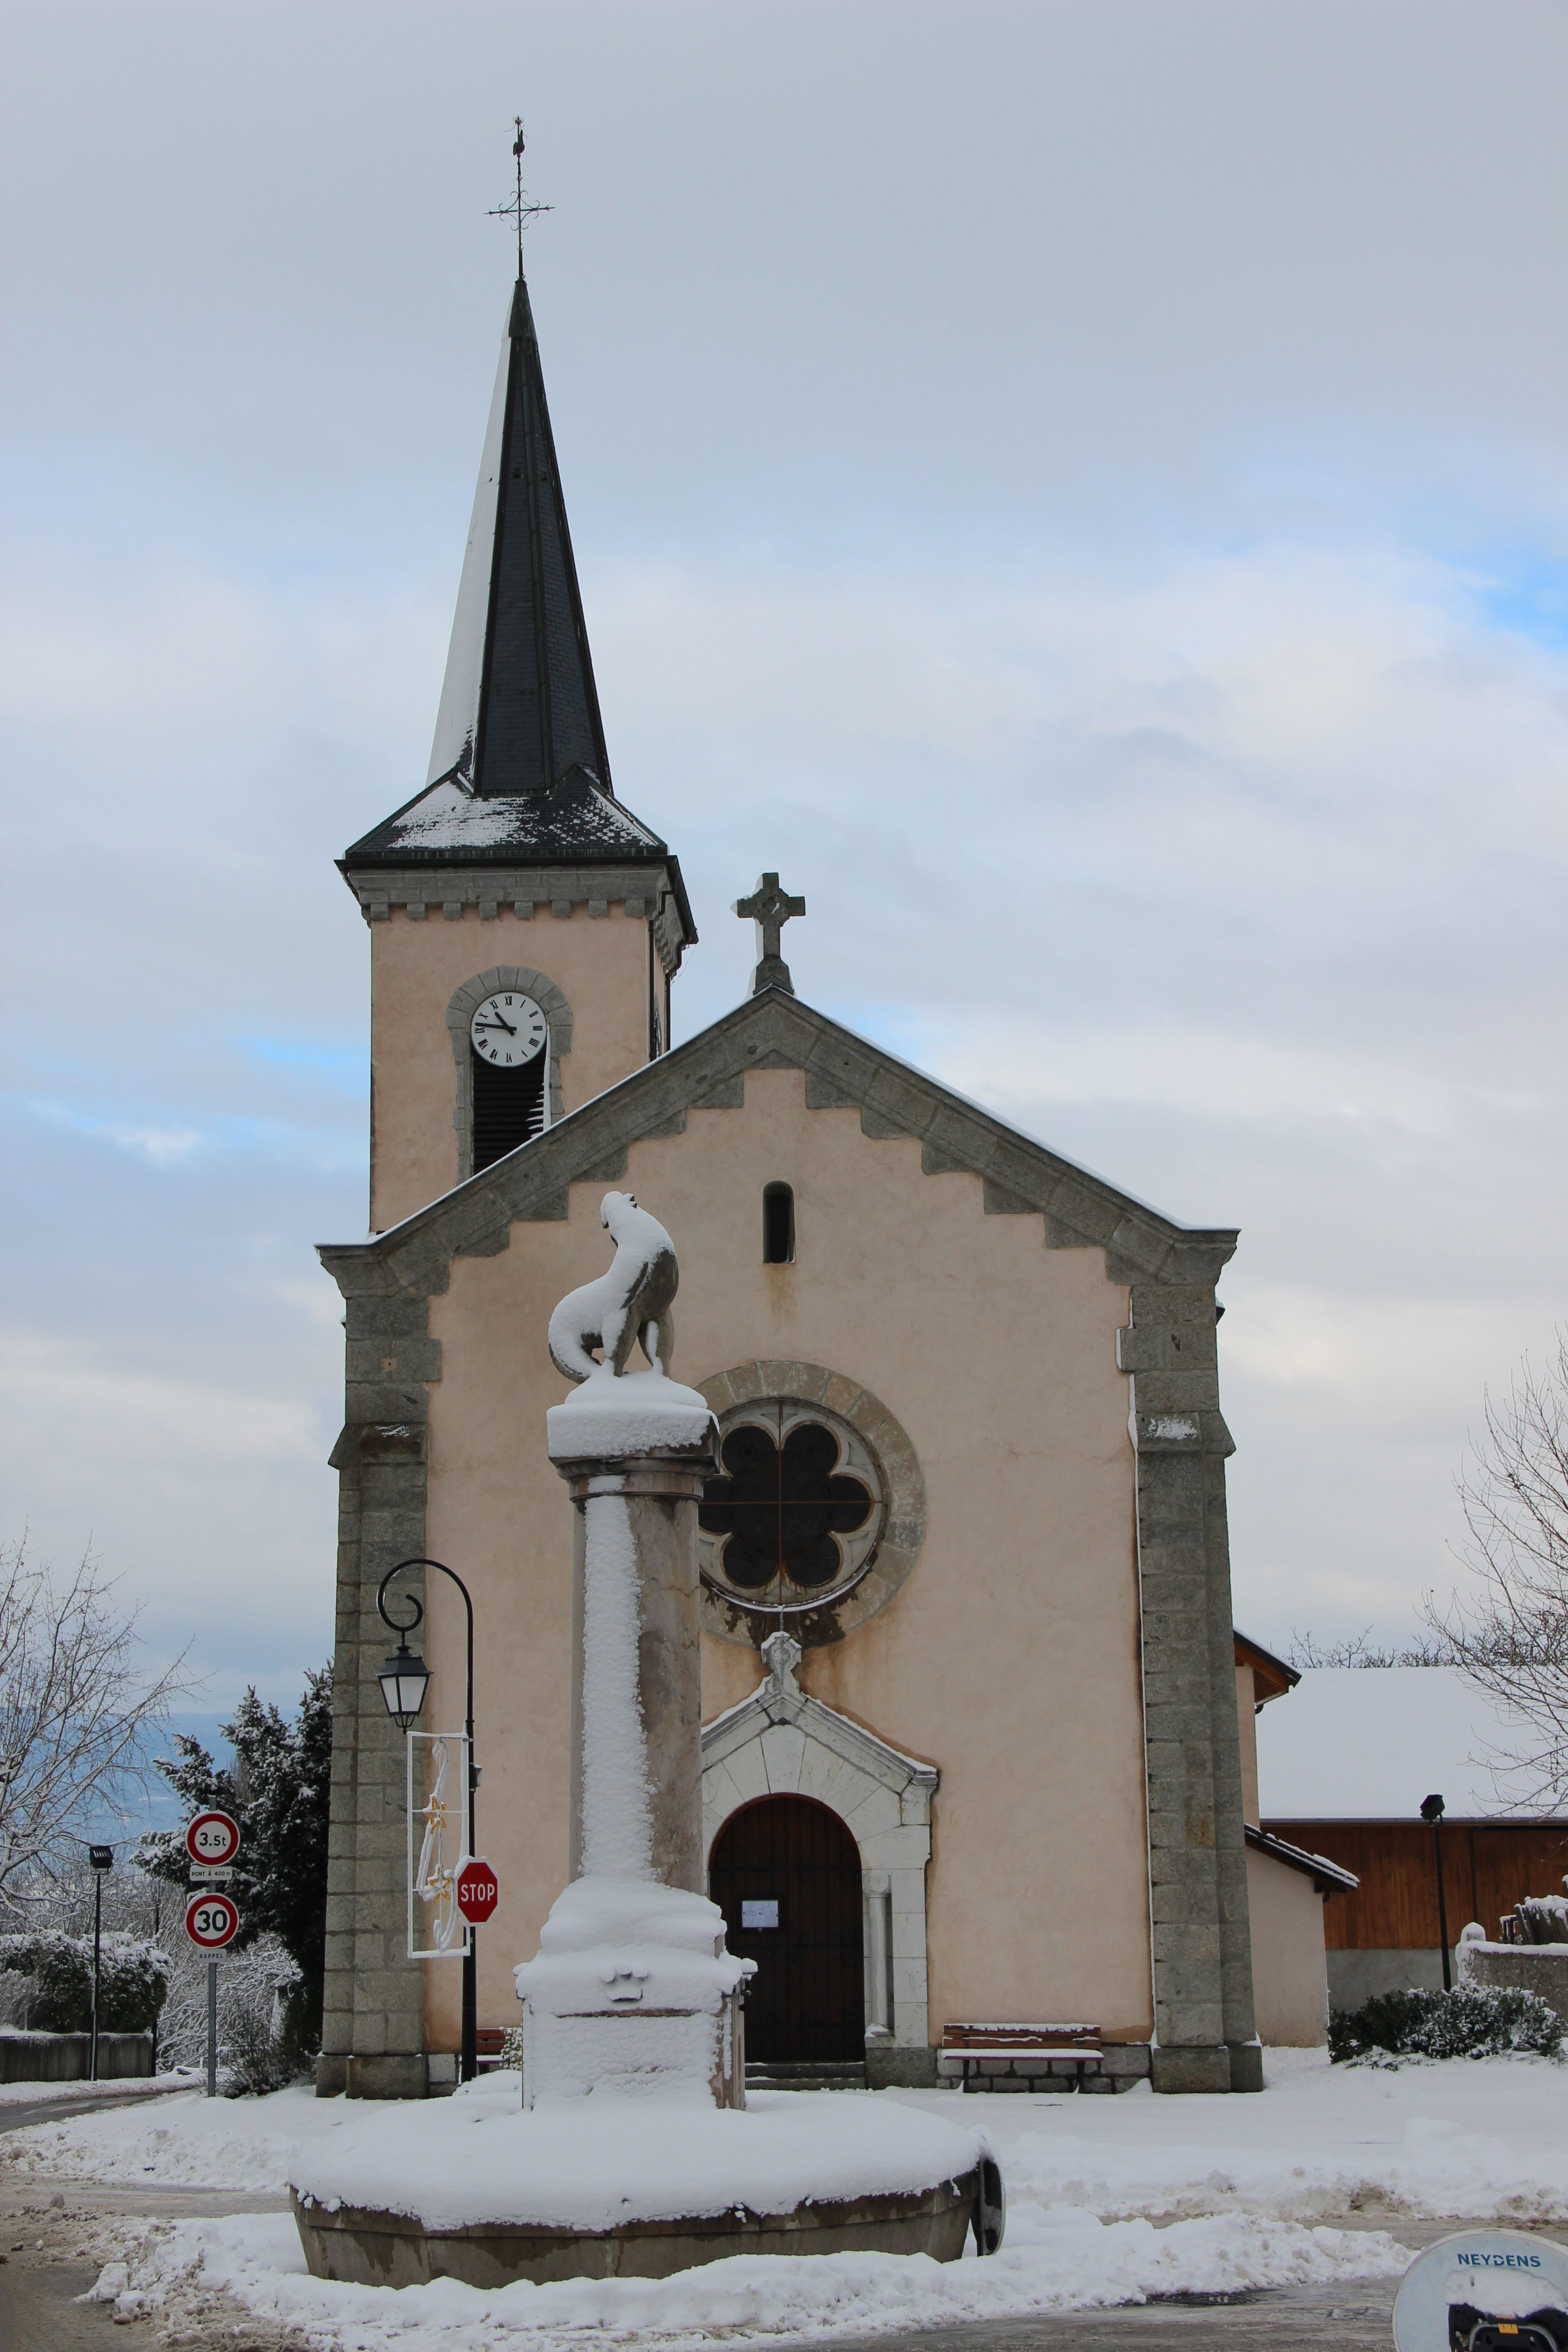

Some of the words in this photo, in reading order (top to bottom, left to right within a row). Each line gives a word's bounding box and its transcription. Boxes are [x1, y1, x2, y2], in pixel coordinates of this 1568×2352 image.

[489, 1000, 499, 1010] XI
[520, 1000, 526, 1009] I
[506, 1052, 512, 1063] VI
[199, 1832, 226, 1847] 3.5t
[461, 1883, 495, 1902] STOP
[196, 1909, 227, 1932] 30
[1457, 2253, 1541, 2267] NEYDENS
